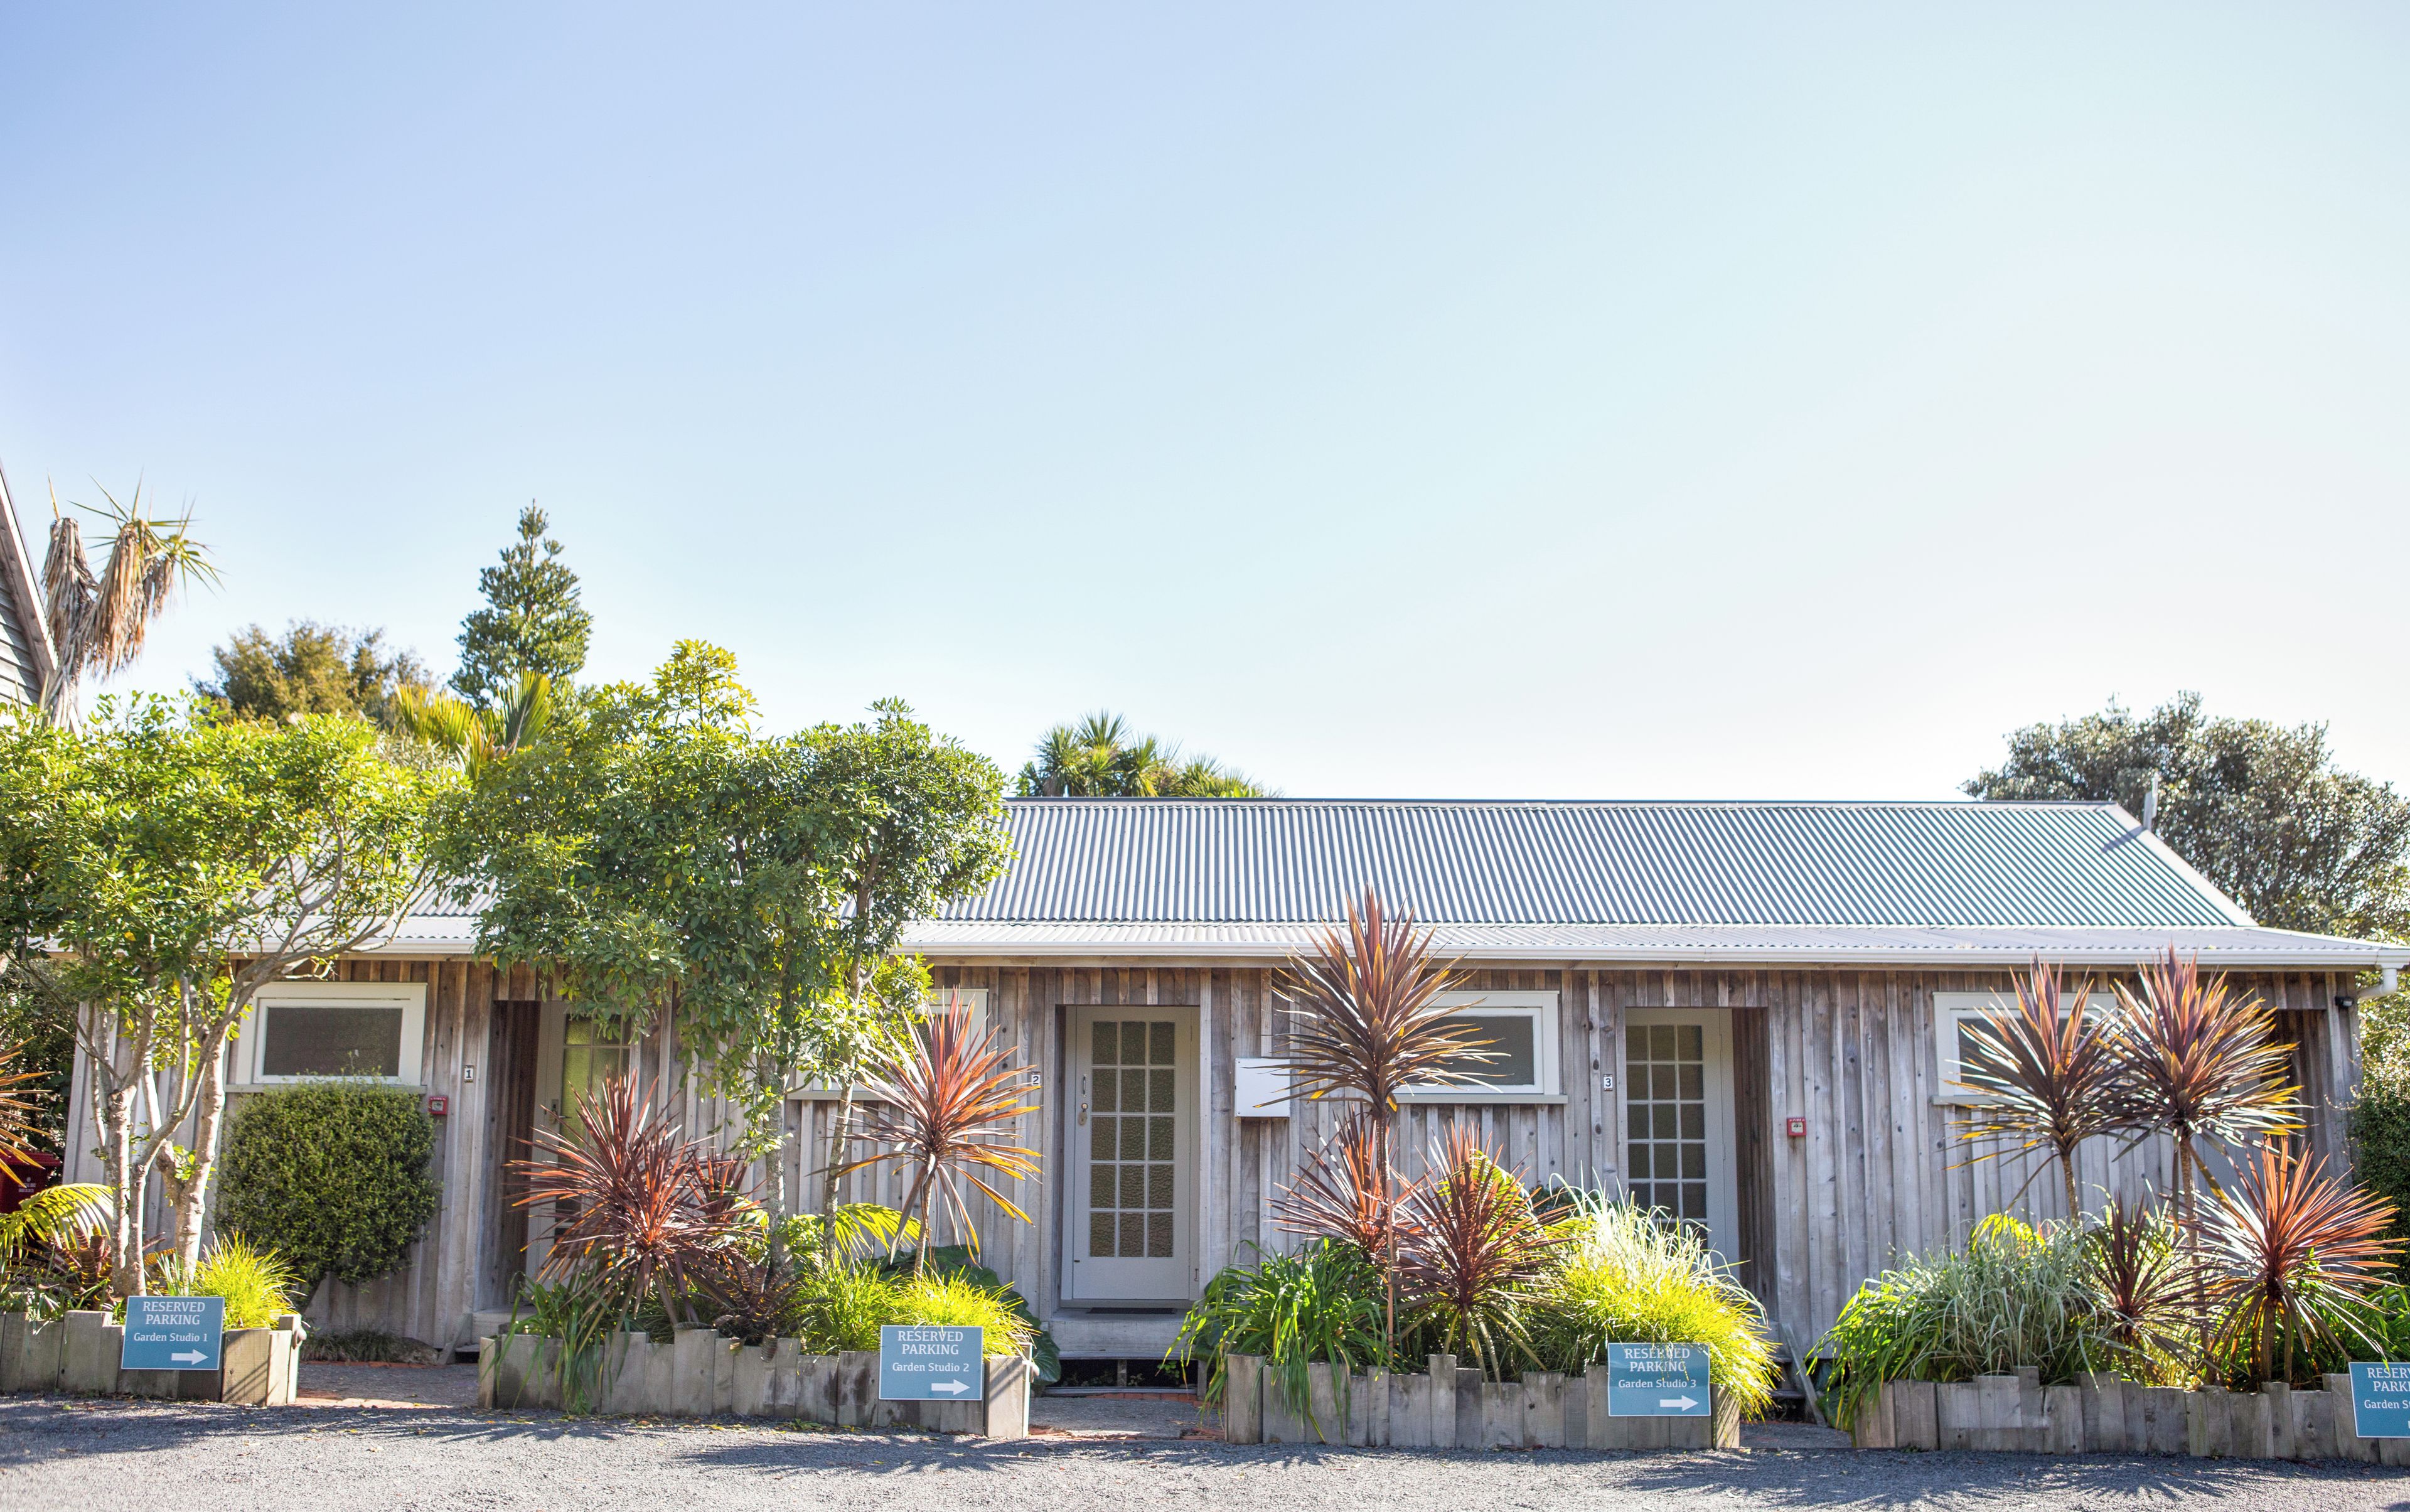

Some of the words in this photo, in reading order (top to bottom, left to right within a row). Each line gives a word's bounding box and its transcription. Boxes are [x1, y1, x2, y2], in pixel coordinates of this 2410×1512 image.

[466, 1070, 471, 1078] 1
[1033, 1076, 1039, 1085] 2
[1605, 1078, 1611, 1086] 3
[142, 1301, 205, 1312] RESERVED
[145, 1314, 200, 1325] PARKING
[134, 1332, 167, 1341] Garden
[169, 1332, 200, 1342] Studio
[203, 1333, 208, 1342] 1
[897, 1331, 963, 1341] RESERVED
[901, 1344, 959, 1354] PARKING
[892, 1362, 925, 1371] Garden
[928, 1363, 960, 1371] Studio
[963, 1363, 969, 1372] 2
[2367, 1368, 2410, 1378] RESER
[1619, 1380, 1653, 1388] Garden
[1656, 1380, 1687, 1388] Studio
[1690, 1380, 1696, 1388] 3
[2364, 1400, 2400, 1409] Garden
